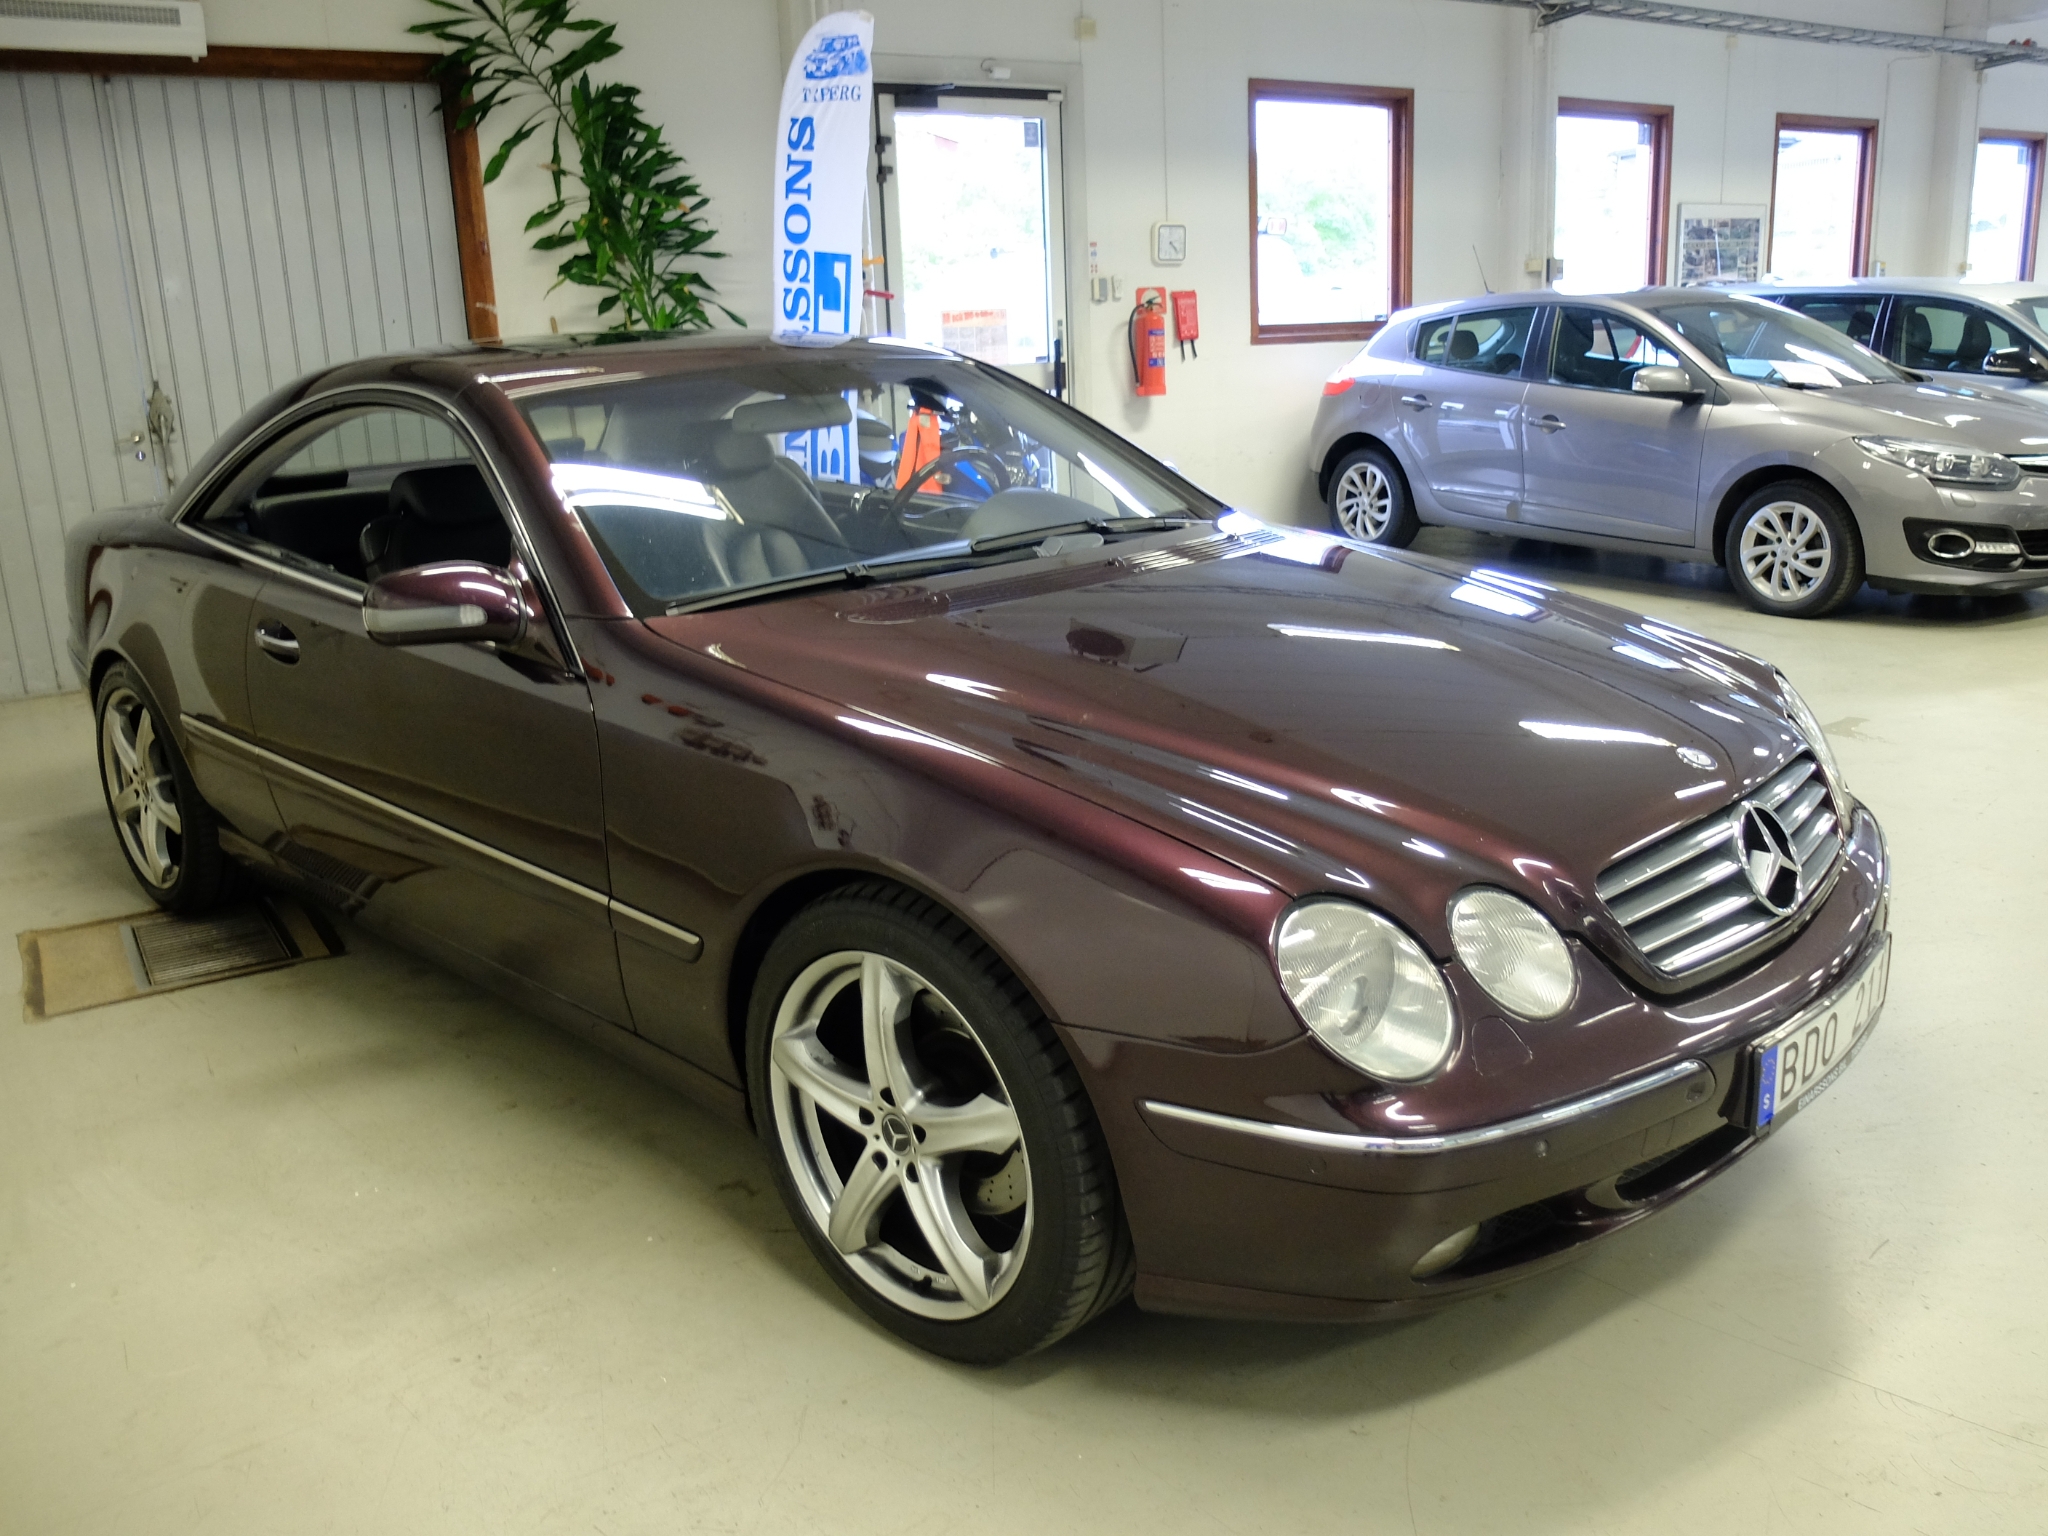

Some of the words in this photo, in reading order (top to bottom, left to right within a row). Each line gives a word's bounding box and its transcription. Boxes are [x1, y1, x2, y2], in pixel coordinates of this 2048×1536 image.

[783, 116, 815, 335] SSONS
[1780, 1011, 1838, 1101] BDO
[1852, 951, 1885, 1038] 211
[1762, 1092, 1771, 1111] S
